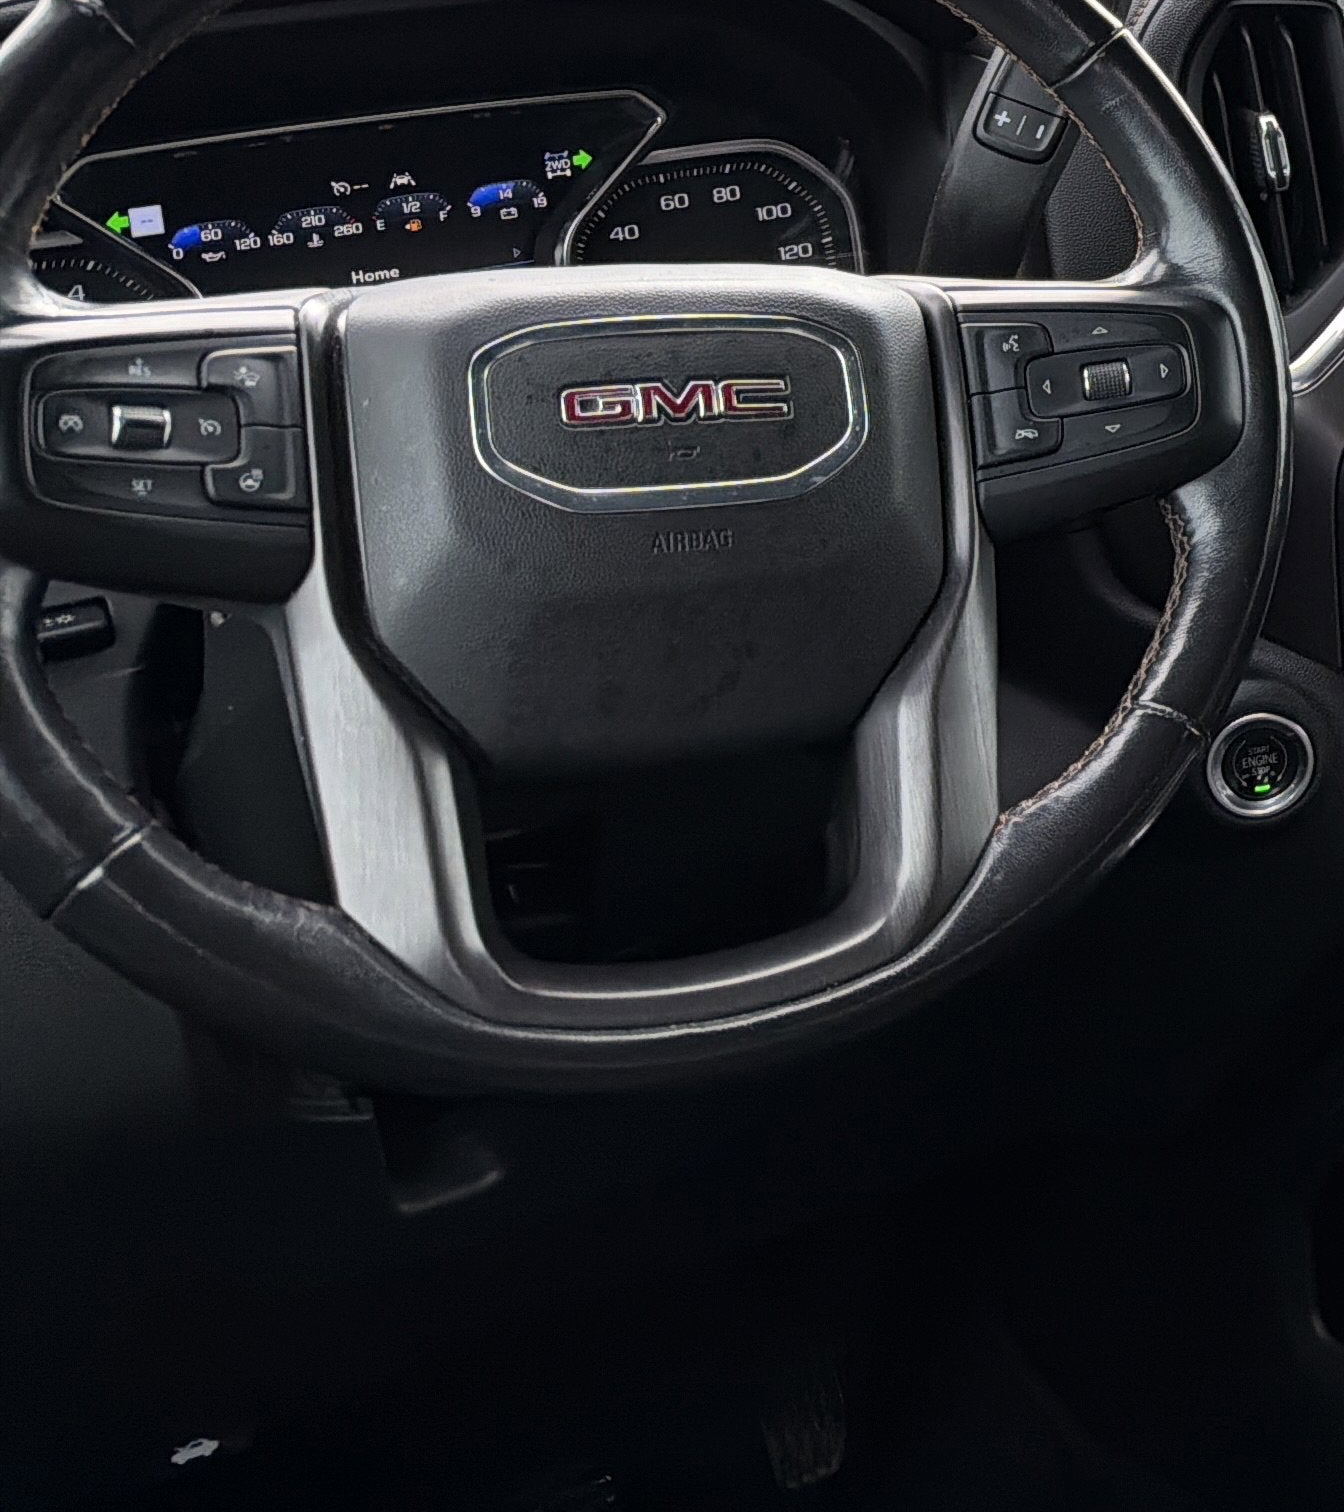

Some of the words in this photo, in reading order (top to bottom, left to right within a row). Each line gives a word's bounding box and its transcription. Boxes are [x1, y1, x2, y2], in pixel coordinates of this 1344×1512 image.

[545, 158, 571, 171] 2WD
[499, 189, 513, 200] 14
[712, 185, 741, 204] 80
[402, 201, 421, 213] 1/2
[531, 196, 548, 209] 19
[660, 193, 690, 212] 60
[439, 209, 448, 222] F
[470, 206, 482, 218] 9
[755, 202, 792, 222] 100
[301, 214, 326, 229] 210
[376, 219, 386, 231] E
[200, 228, 223, 242] 60
[333, 222, 363, 238] 260
[609, 224, 640, 242] 40
[234, 236, 262, 251] 120
[267, 232, 295, 247] 160
[172, 247, 184, 260] 0
[777, 242, 814, 261] 120
[351, 267, 400, 285] Home
[560, 379, 793, 428] GMC
[653, 528, 735, 555] AIRBAG
[1242, 753, 1279, 769] ENGINE
